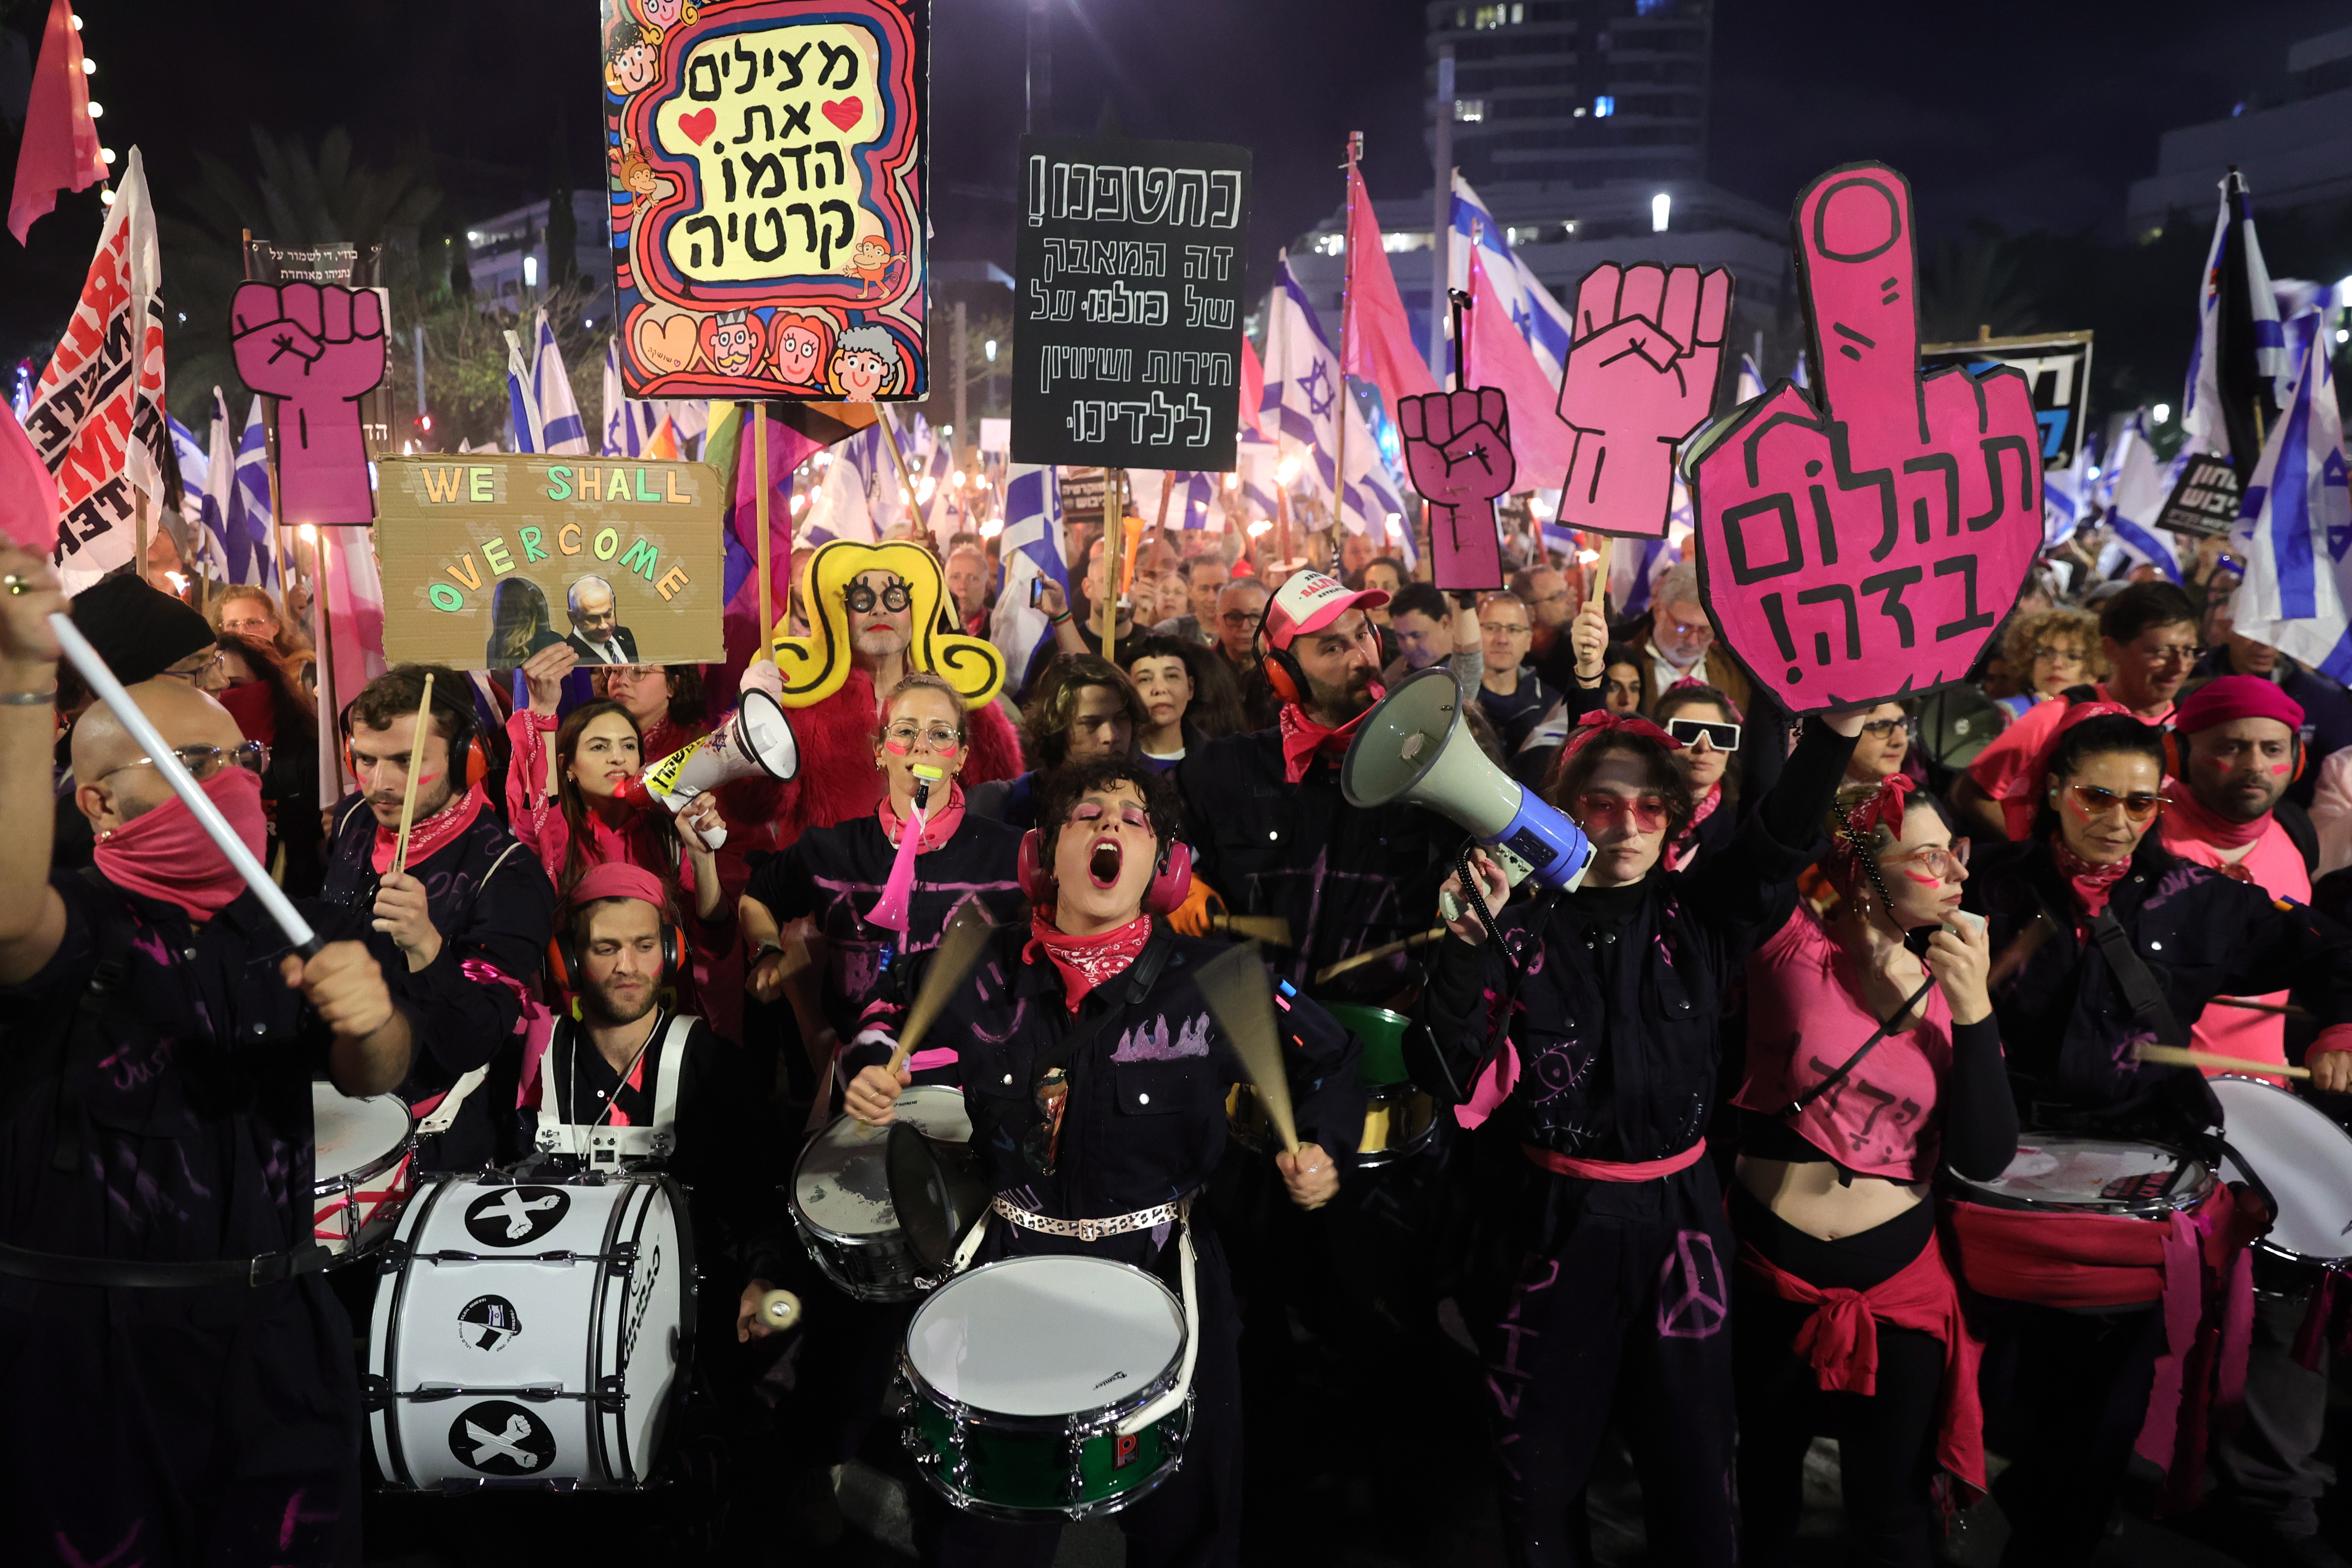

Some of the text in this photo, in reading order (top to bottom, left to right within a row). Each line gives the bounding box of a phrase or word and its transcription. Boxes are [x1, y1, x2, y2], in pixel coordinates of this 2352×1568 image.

[688, 39, 858, 101] מצילים
[733, 101, 811, 144] את
[1029, 155, 1241, 228] נחטפנו!
[269, 247, 284, 260] על
[287, 250, 321, 262] לשמור
[323, 251, 332, 259] די
[686, 199, 855, 269] קרטיה
[281, 269, 350, 280] נתניהו מאוחדת
[1043, 238, 1234, 282] זה המאבק
[1030, 279, 1075, 321] על
[1185, 285, 1234, 329] של
[1041, 345, 1231, 393] חירות ושיוויון
[421, 465, 692, 504] WE SHALL
[428, 522, 691, 612] OVERCOME
[1760, 554, 1994, 684] בזה!
